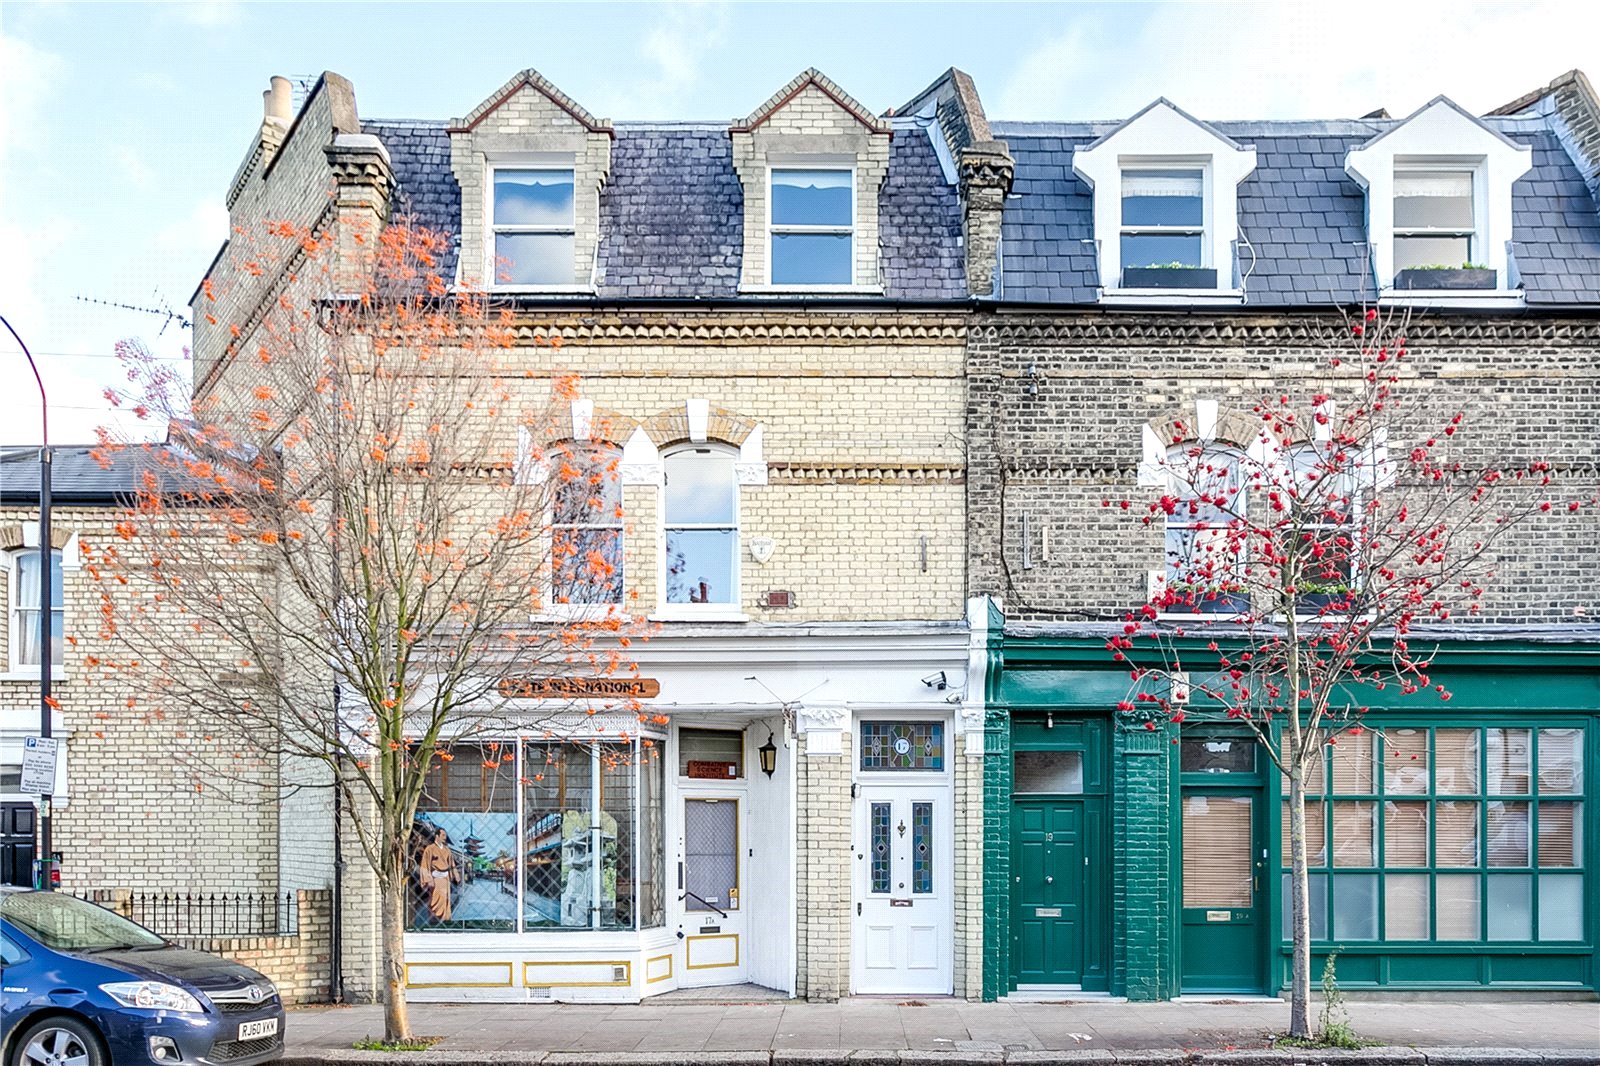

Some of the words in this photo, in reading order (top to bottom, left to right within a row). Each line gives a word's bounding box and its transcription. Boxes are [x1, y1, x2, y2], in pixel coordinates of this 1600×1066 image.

[898, 742, 907, 750] 17
[1045, 832, 1054, 841] 19
[242, 1023, 261, 1037] RJ60
